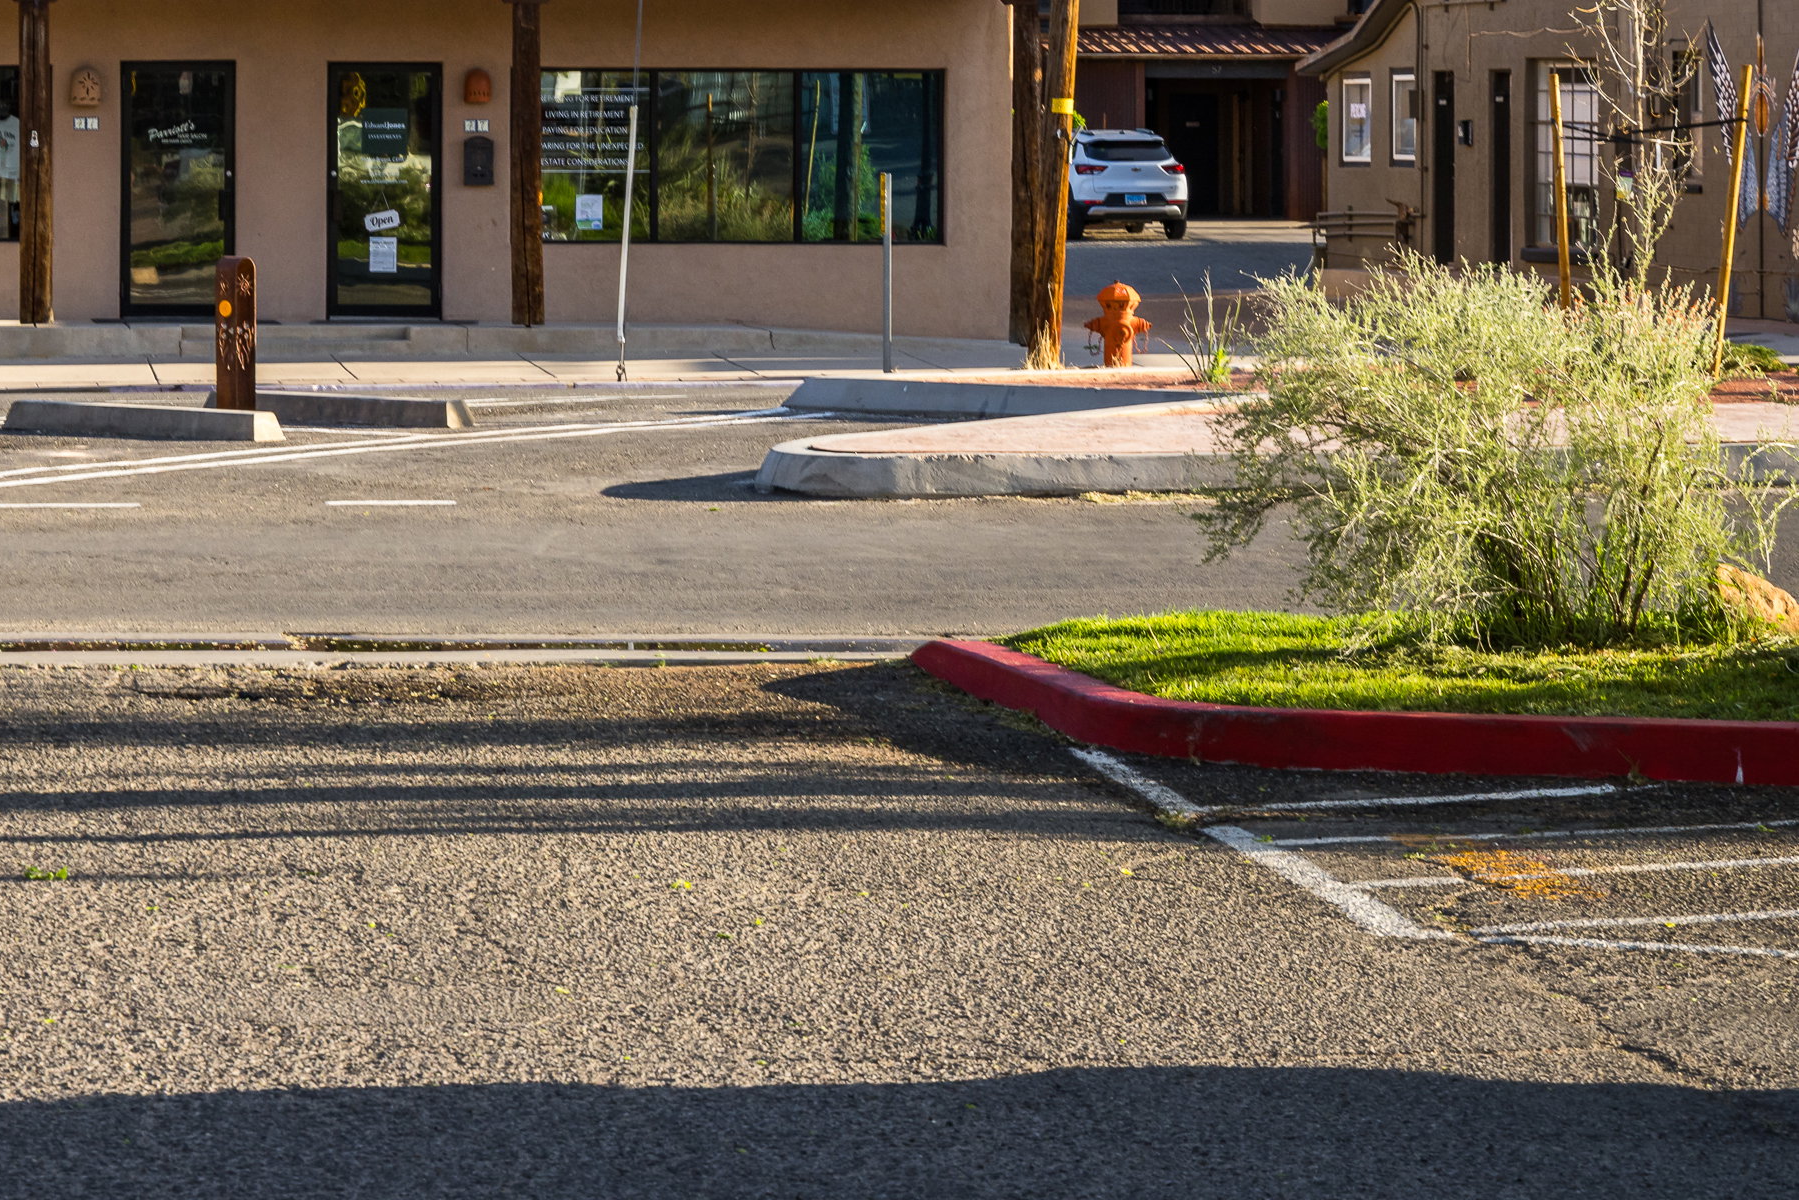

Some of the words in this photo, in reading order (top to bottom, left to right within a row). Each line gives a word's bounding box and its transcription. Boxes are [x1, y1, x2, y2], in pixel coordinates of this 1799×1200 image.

[545, 110, 569, 118] LIVING
[571, 110, 579, 118] IN
[580, 110, 624, 118] RETIREMENT
[542, 126, 569, 134] PAYING
[369, 215, 394, 228] Open
